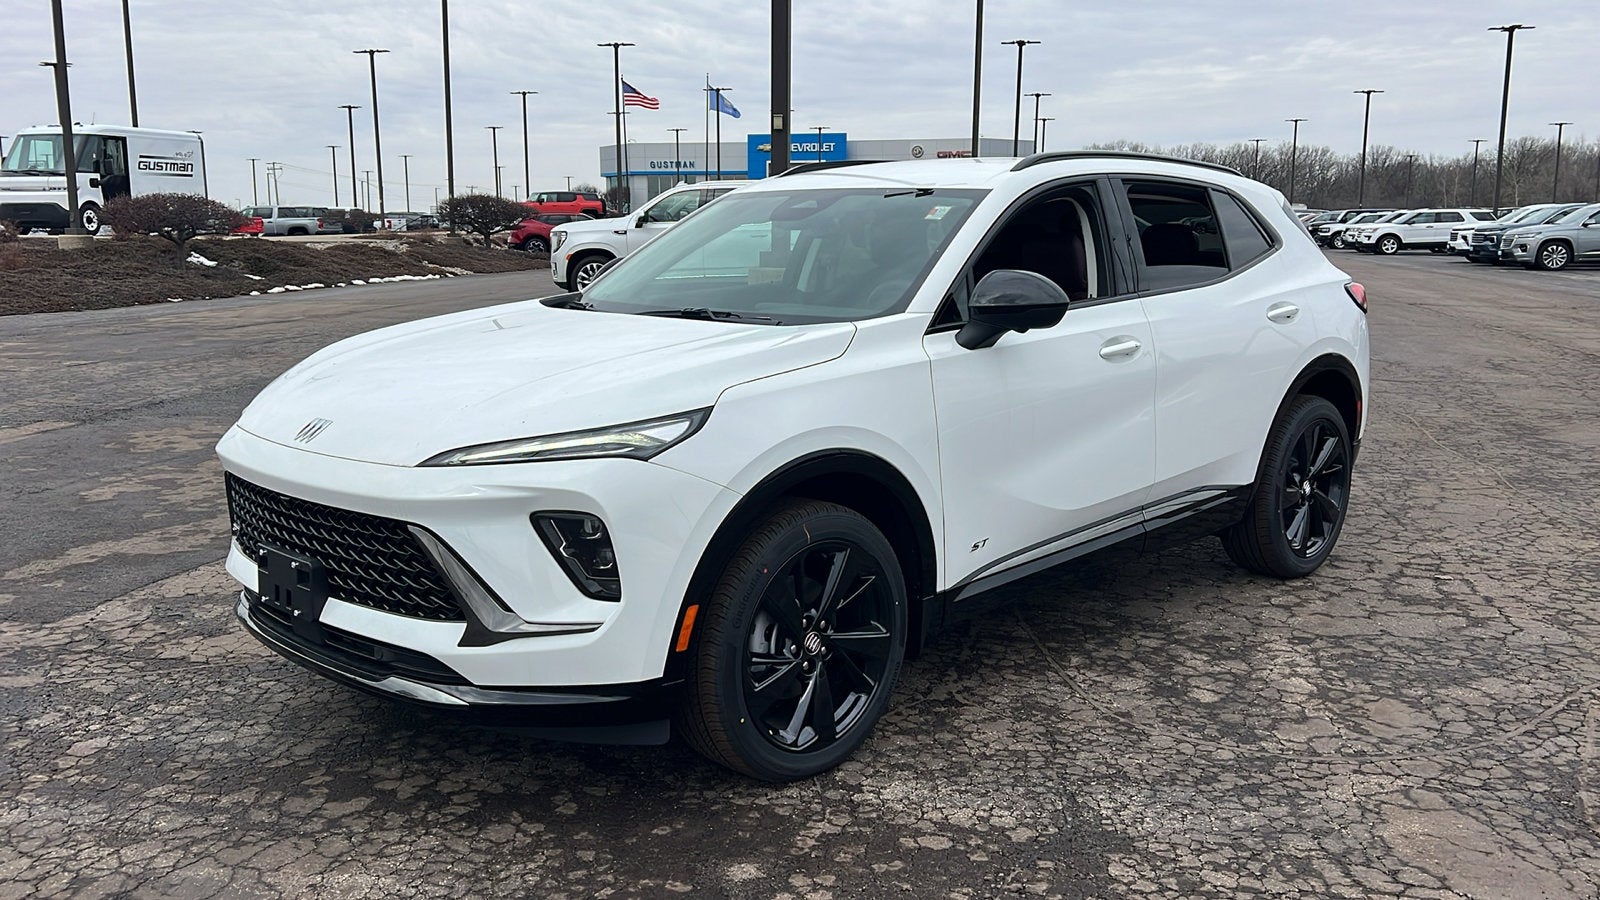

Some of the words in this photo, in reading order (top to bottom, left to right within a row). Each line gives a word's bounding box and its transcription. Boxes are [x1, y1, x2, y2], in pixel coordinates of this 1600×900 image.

[790, 142, 836, 152] EVROLET
[936, 150, 972, 158] GMC
[649, 160, 695, 169] GUSTMAN
[969, 537, 989, 553] ST
